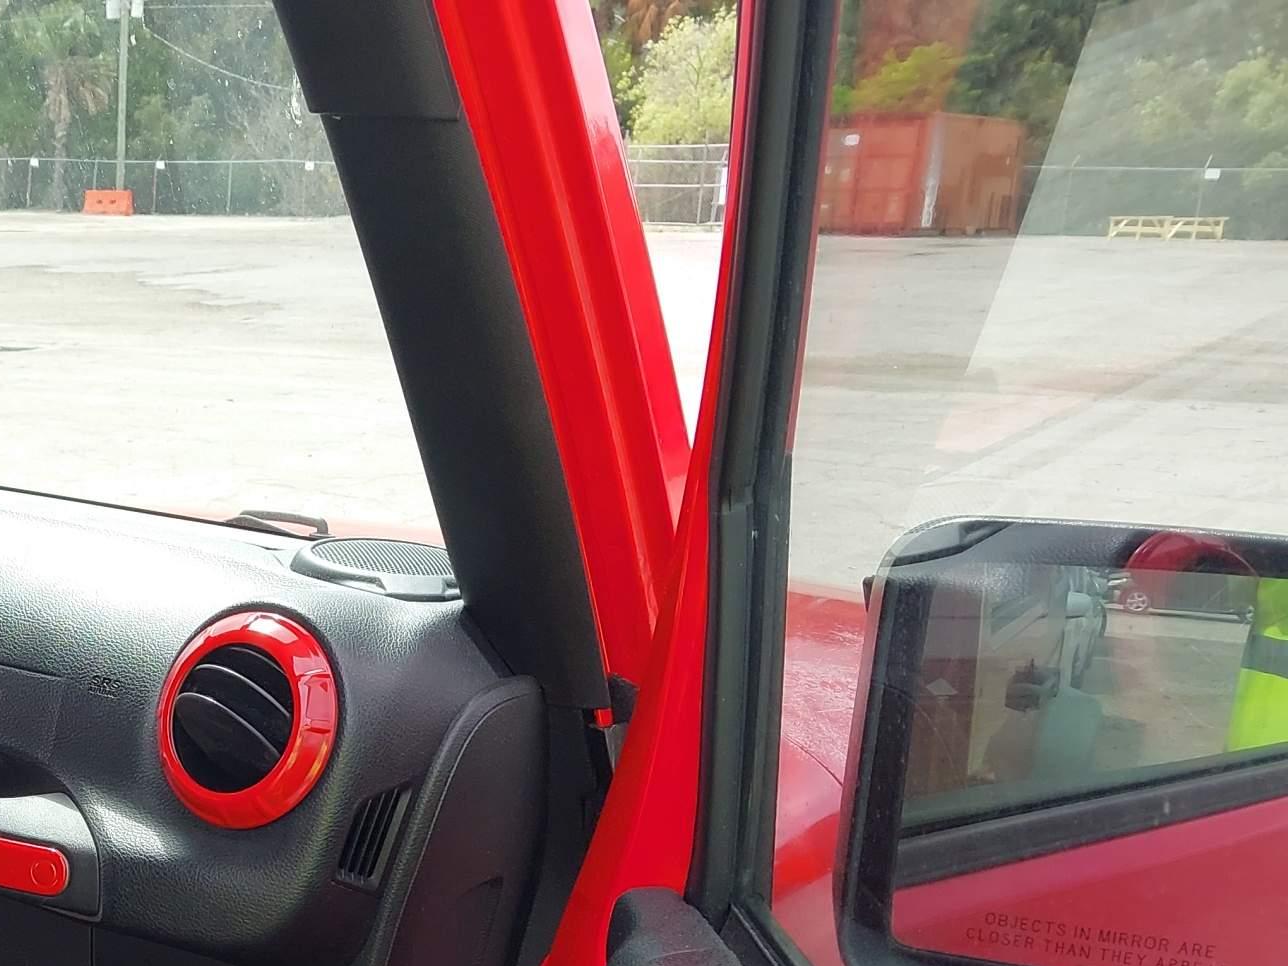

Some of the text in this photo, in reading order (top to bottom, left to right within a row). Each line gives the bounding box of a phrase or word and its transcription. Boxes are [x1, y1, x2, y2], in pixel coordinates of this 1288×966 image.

[966, 927, 1034, 949] CLOSER
[1044, 939, 1090, 959] THAN
[1101, 948, 1147, 966] THEY
[985, 912, 1216, 959] OBJECTS IN MIRROR ARE
